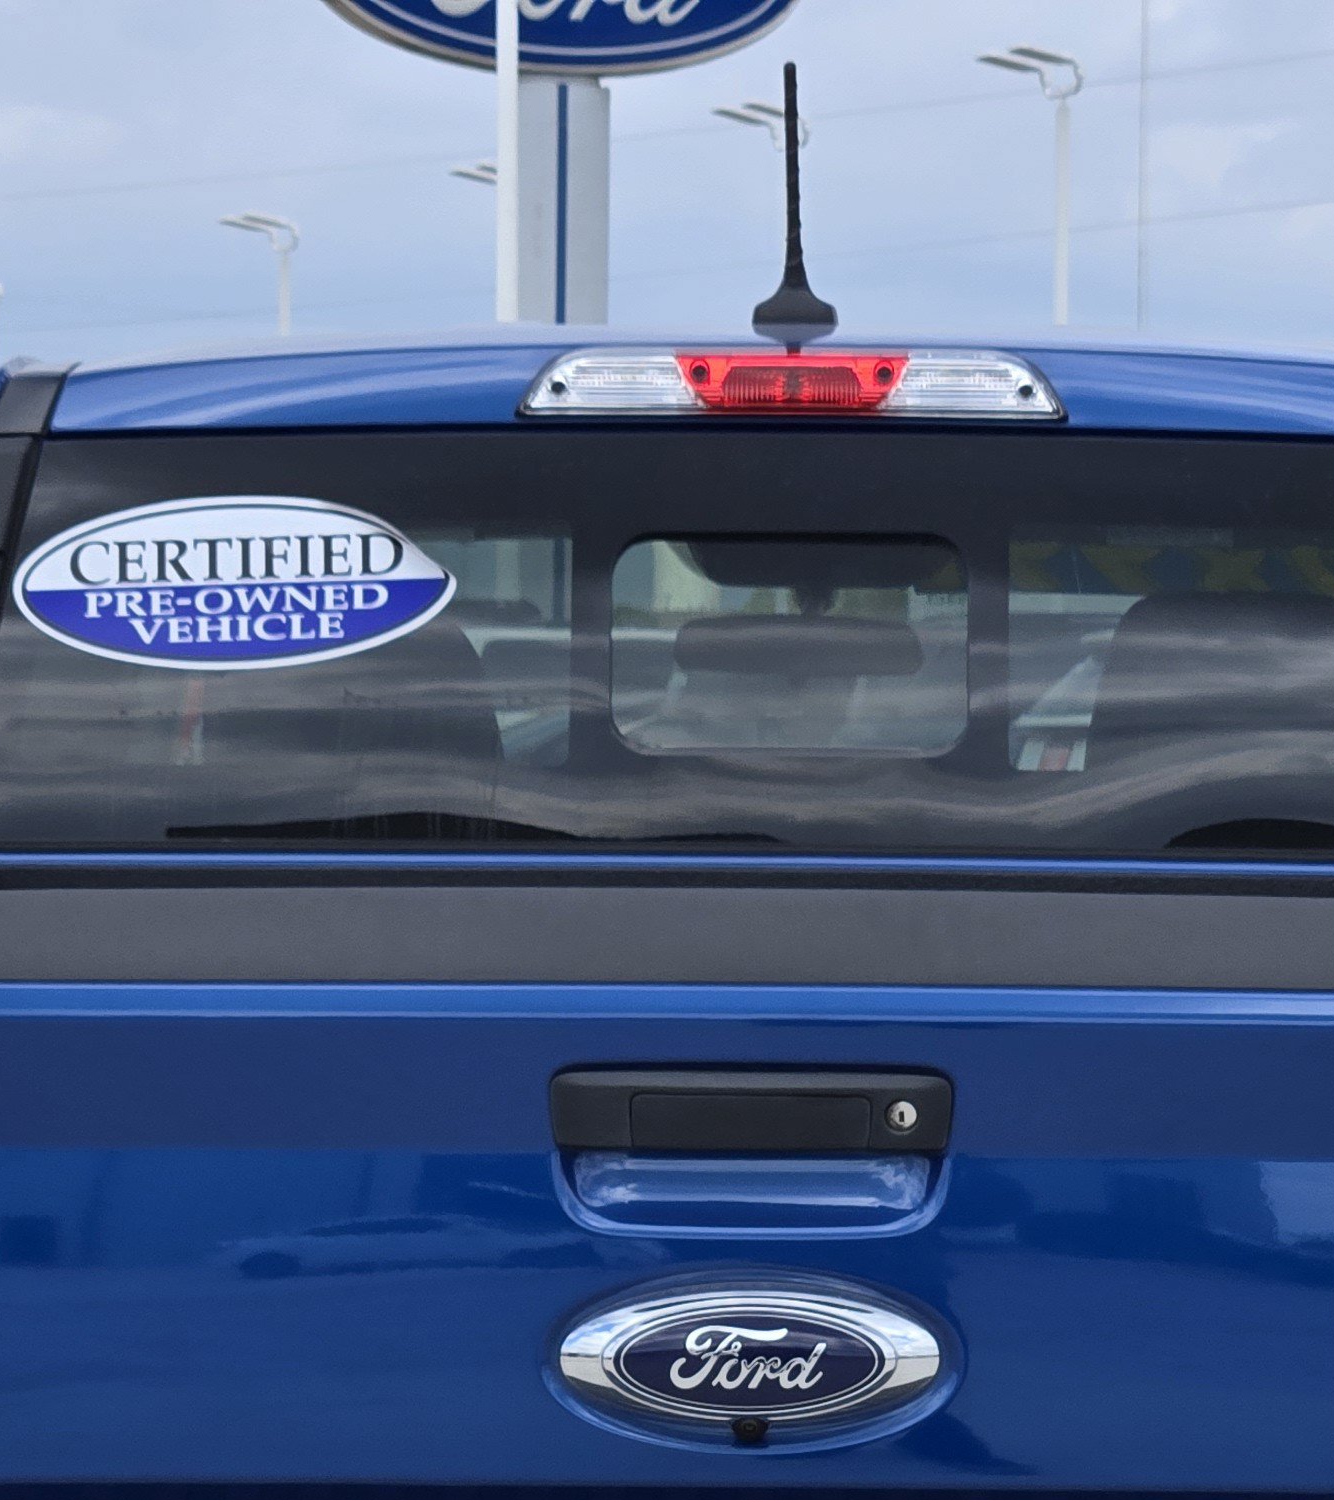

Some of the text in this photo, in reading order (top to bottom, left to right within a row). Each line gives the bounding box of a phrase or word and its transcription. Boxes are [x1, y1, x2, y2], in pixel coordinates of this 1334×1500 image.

[69, 532, 404, 586] CERTIFIED
[83, 582, 389, 619] PRE-OWNED
[128, 612, 345, 645] VEHICLE
[669, 1324, 827, 1390] Ford
